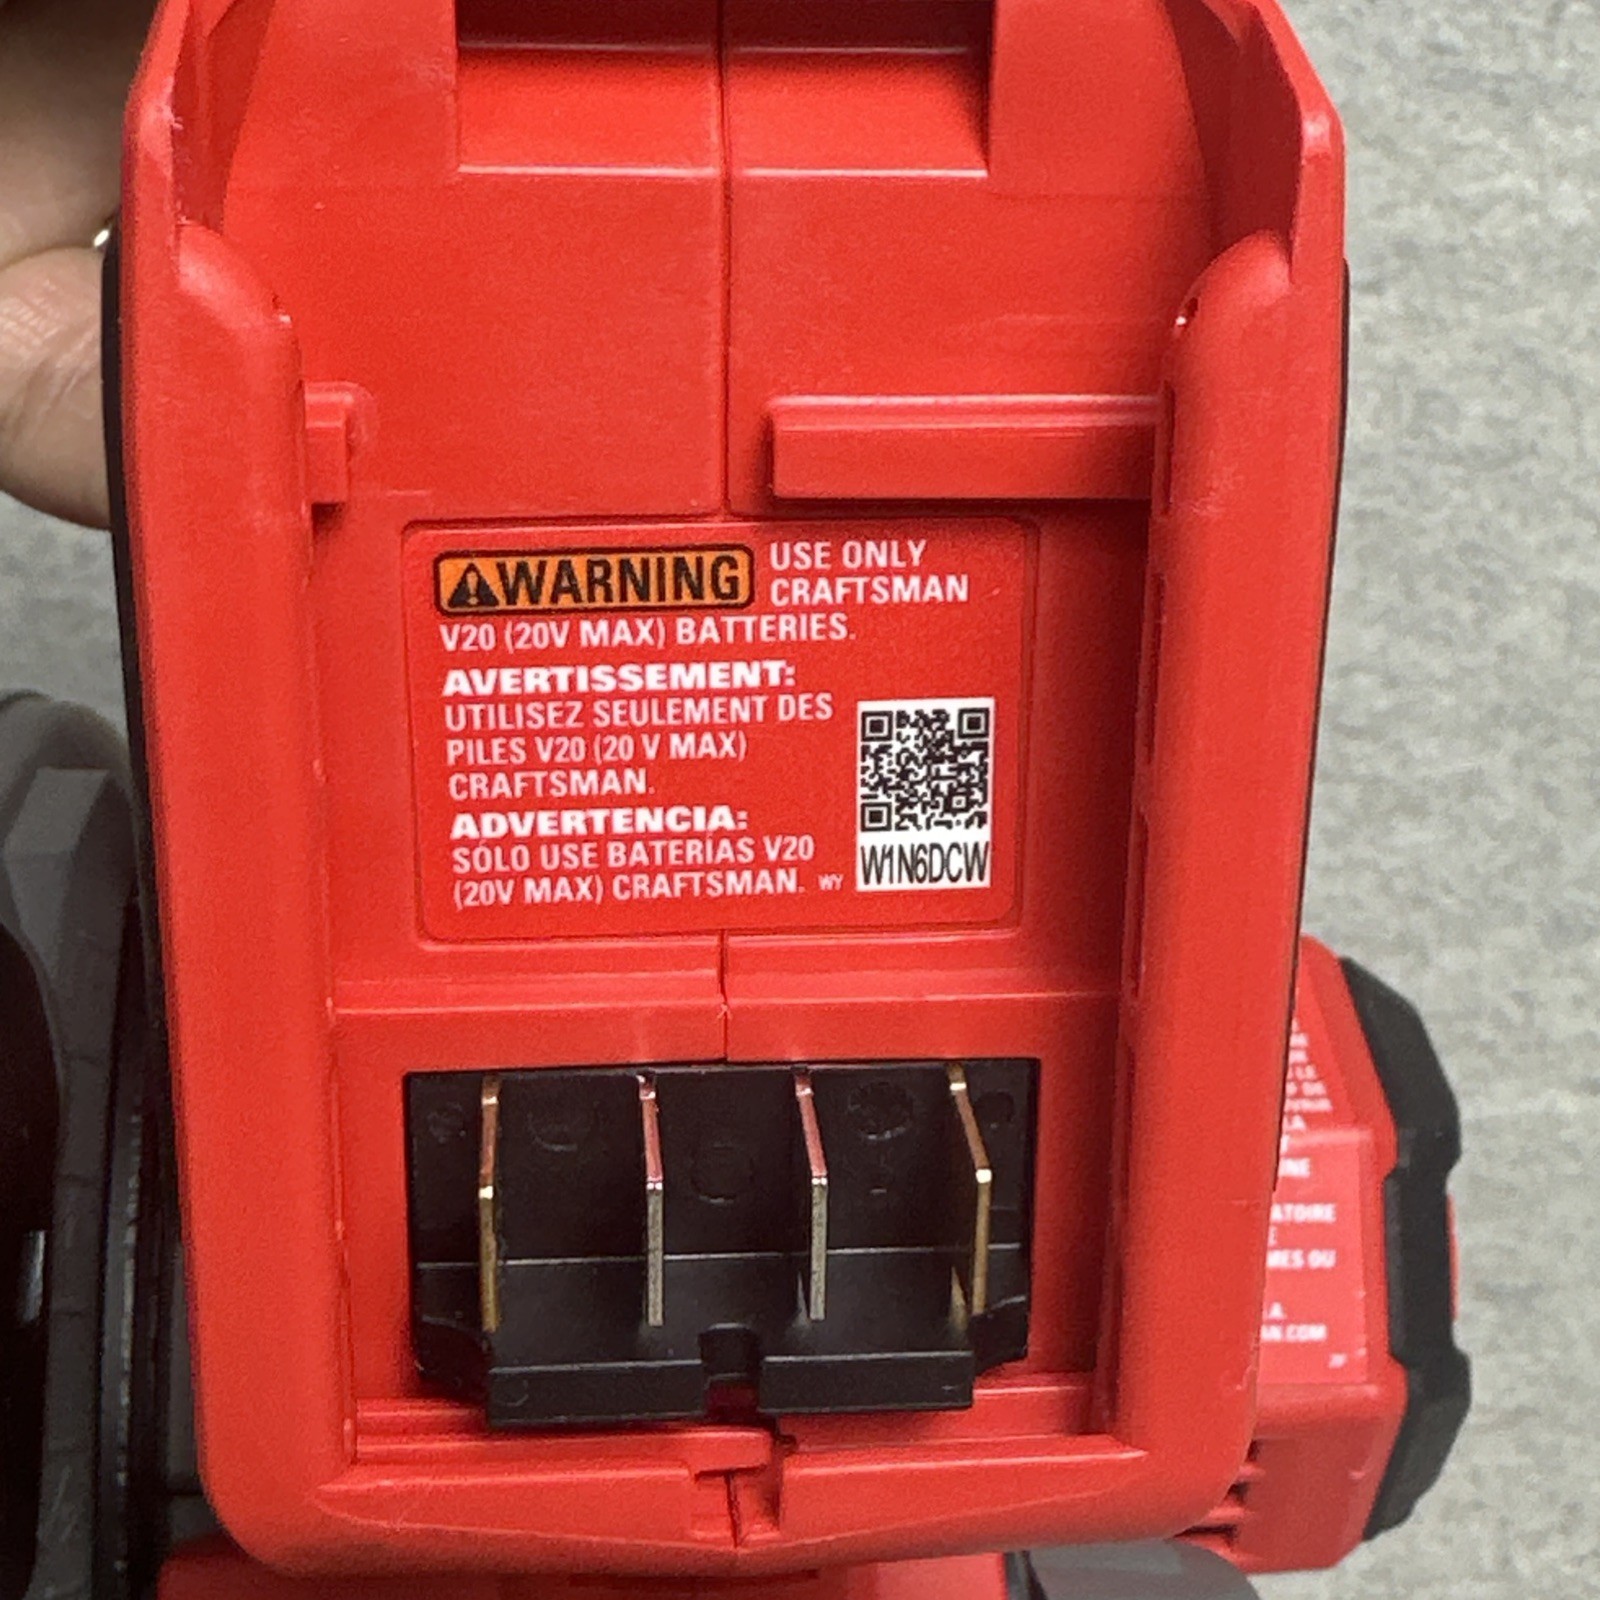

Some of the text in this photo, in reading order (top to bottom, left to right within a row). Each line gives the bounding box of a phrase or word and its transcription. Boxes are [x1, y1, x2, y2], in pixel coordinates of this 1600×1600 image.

[771, 540, 925, 570] USE ONLY
[497, 555, 740, 608] WARNING
[771, 575, 967, 606] CRAFTSMAN
[440, 613, 856, 653] V20 (20V MAX) BATTERIES.
[443, 661, 795, 697] AVERTISSEMENT:
[445, 693, 832, 731] UTILISEZ SEULEMENT DES
[447, 732, 746, 765] PILES V20 (20 V MAX)
[450, 768, 654, 800] CRAFTSMAN.
[451, 806, 748, 839] ADVERTENCIA:
[453, 835, 814, 873] SÓLO USE BATERÍAS V20
[861, 841, 989, 884] W1N6DCW
[454, 868, 803, 910] (20V MAX) CRAFTSMAN.
